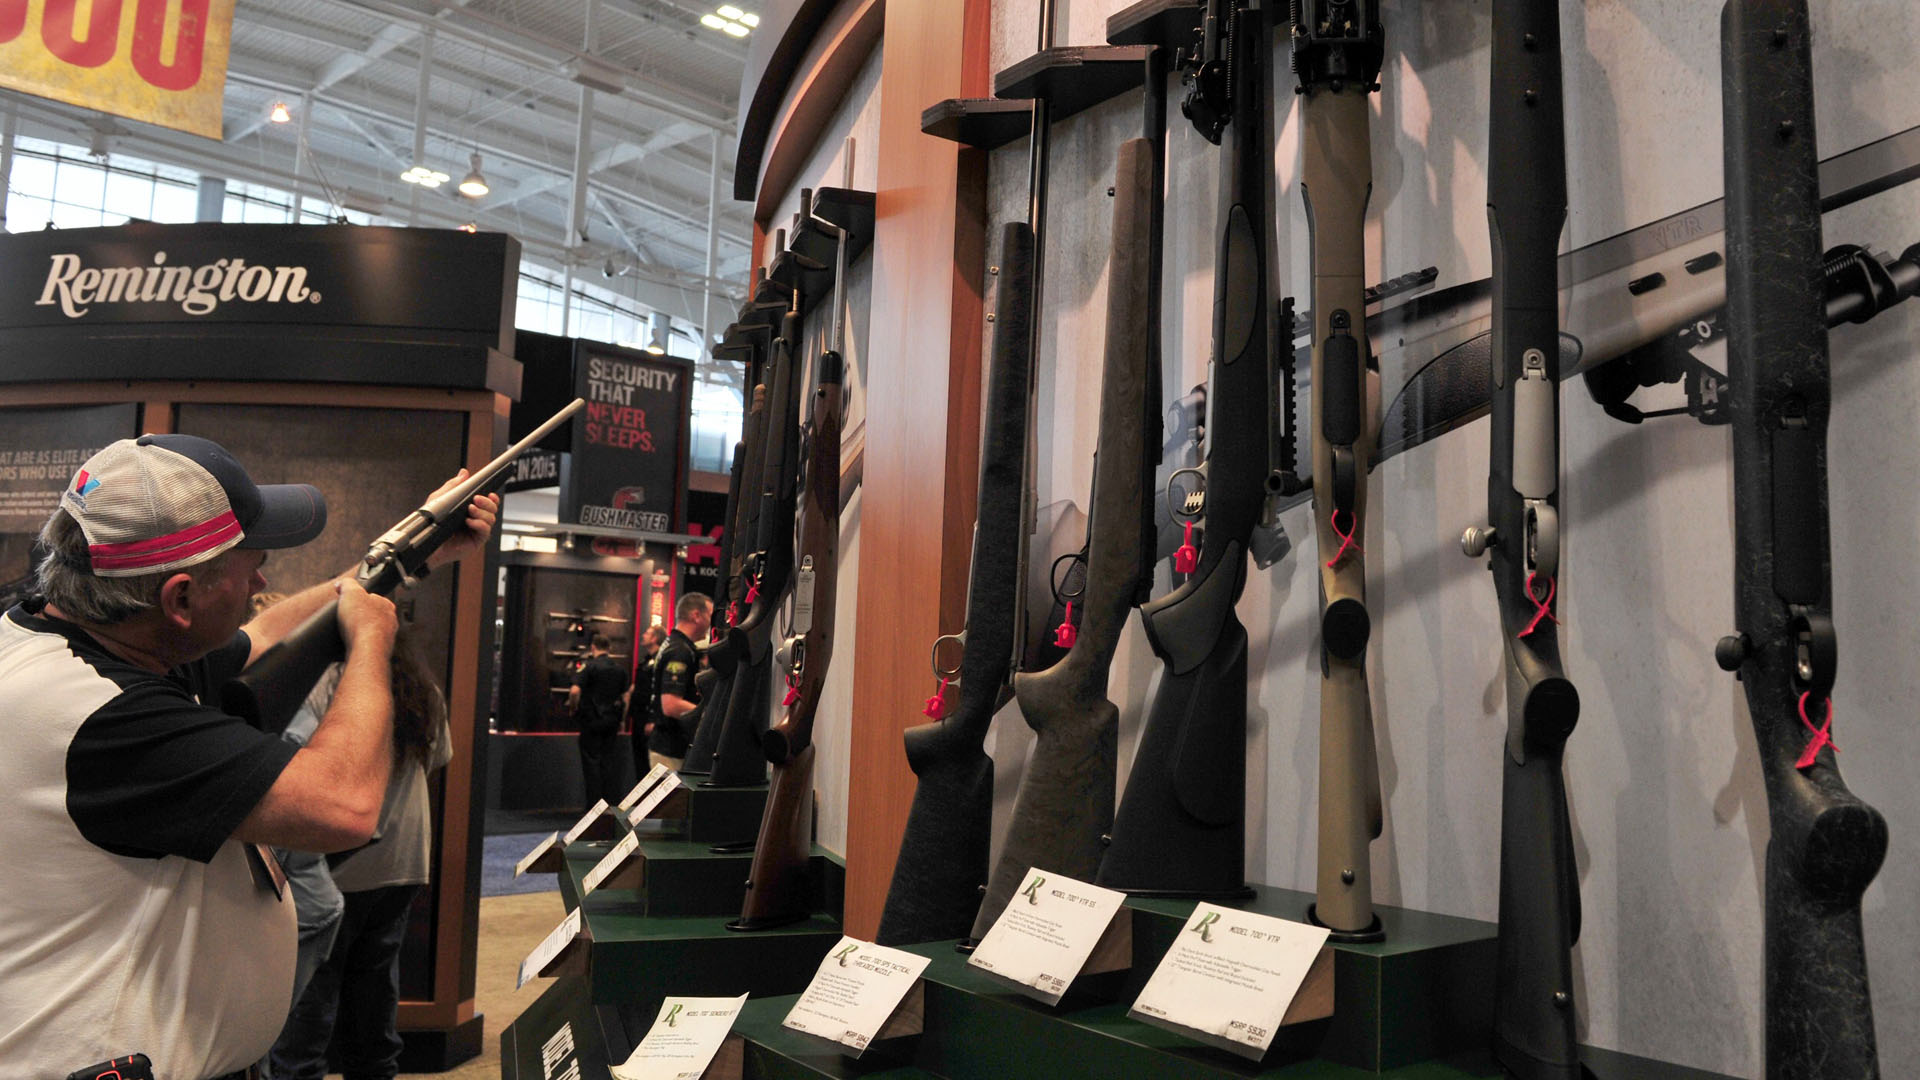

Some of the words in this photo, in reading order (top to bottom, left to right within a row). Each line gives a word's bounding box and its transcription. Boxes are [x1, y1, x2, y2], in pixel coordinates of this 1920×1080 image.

[589, 358, 676, 392] SECURITY
[588, 379, 635, 406] THAT
[586, 401, 646, 429] NEVER
[14, 451, 35, 465] ARE
[36, 450, 50, 464] AS
[51, 449, 78, 464] ELITE
[19, 465, 46, 480] WHO
[48, 465, 68, 479] USE
[580, 504, 669, 533] BUSHMASTER
[1229, 926, 1248, 936] MODEL
[1267, 934, 1280, 943] VTR
[1230, 1020, 1248, 1029] MSRP
